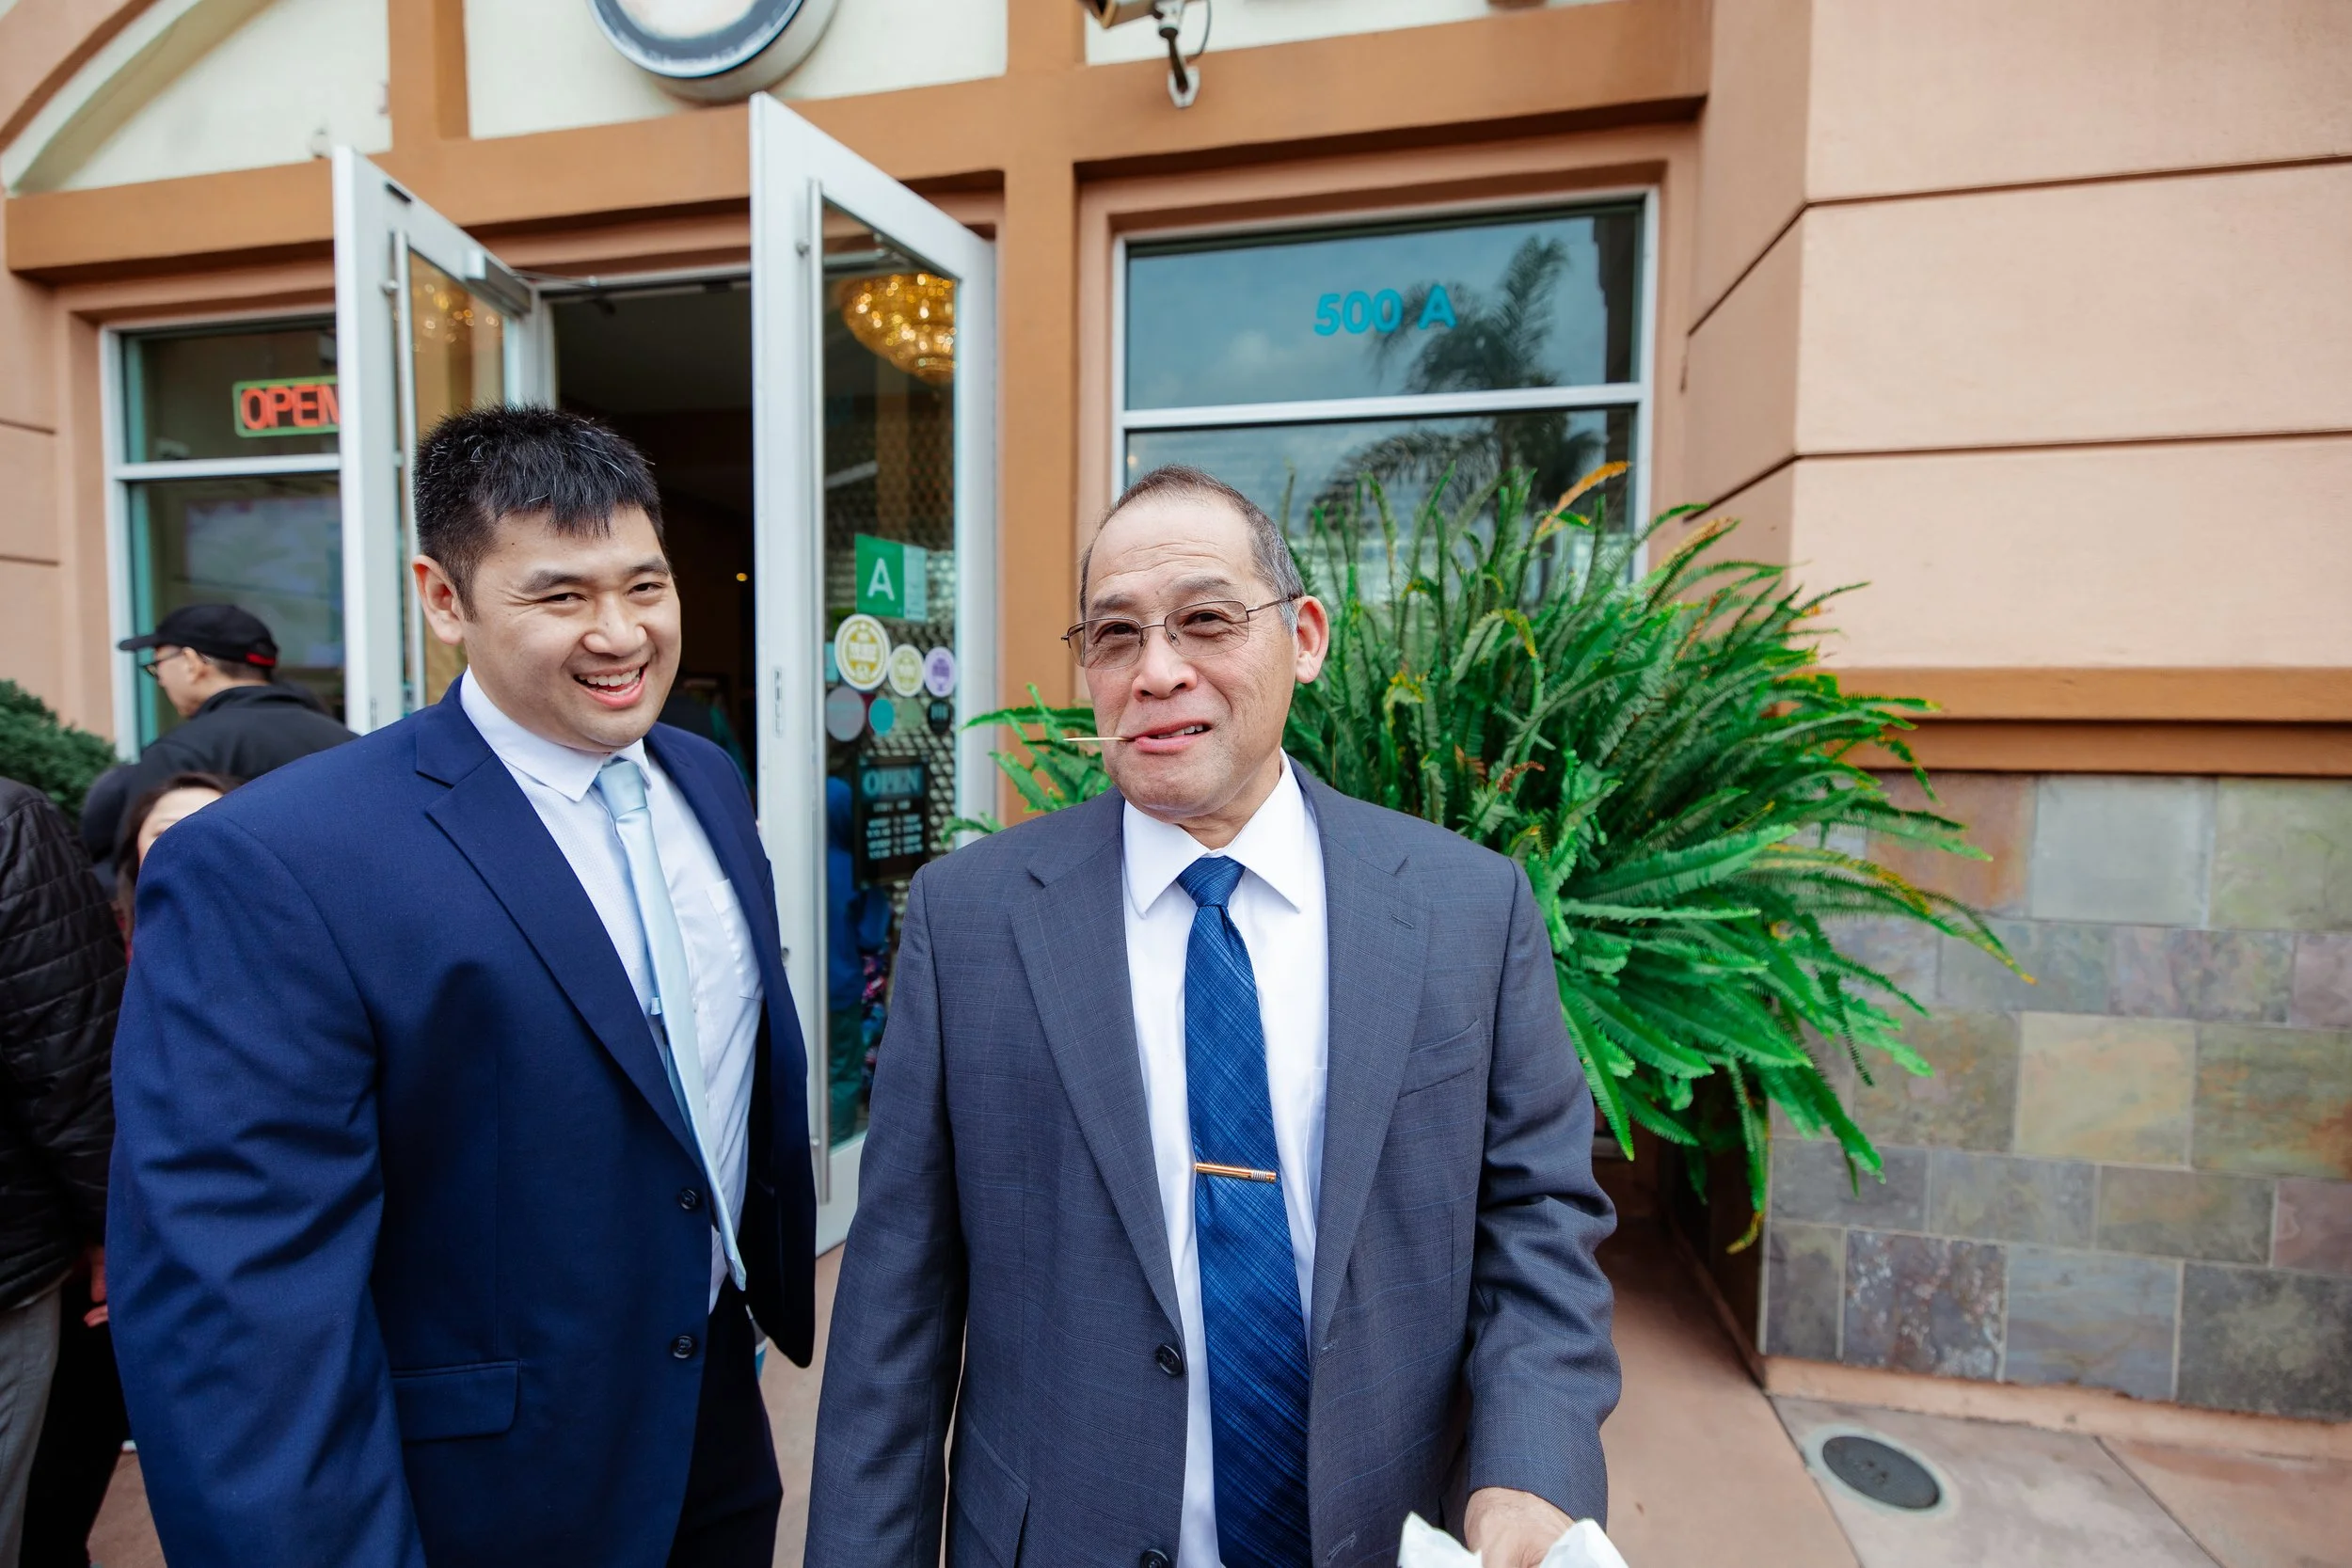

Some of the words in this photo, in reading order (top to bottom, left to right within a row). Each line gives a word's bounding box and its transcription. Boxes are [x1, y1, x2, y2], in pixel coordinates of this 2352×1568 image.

[1313, 288, 1404, 336] 500
[1417, 284, 1457, 329] A
[240, 384, 340, 430] OPEN
[867, 557, 895, 601] A
